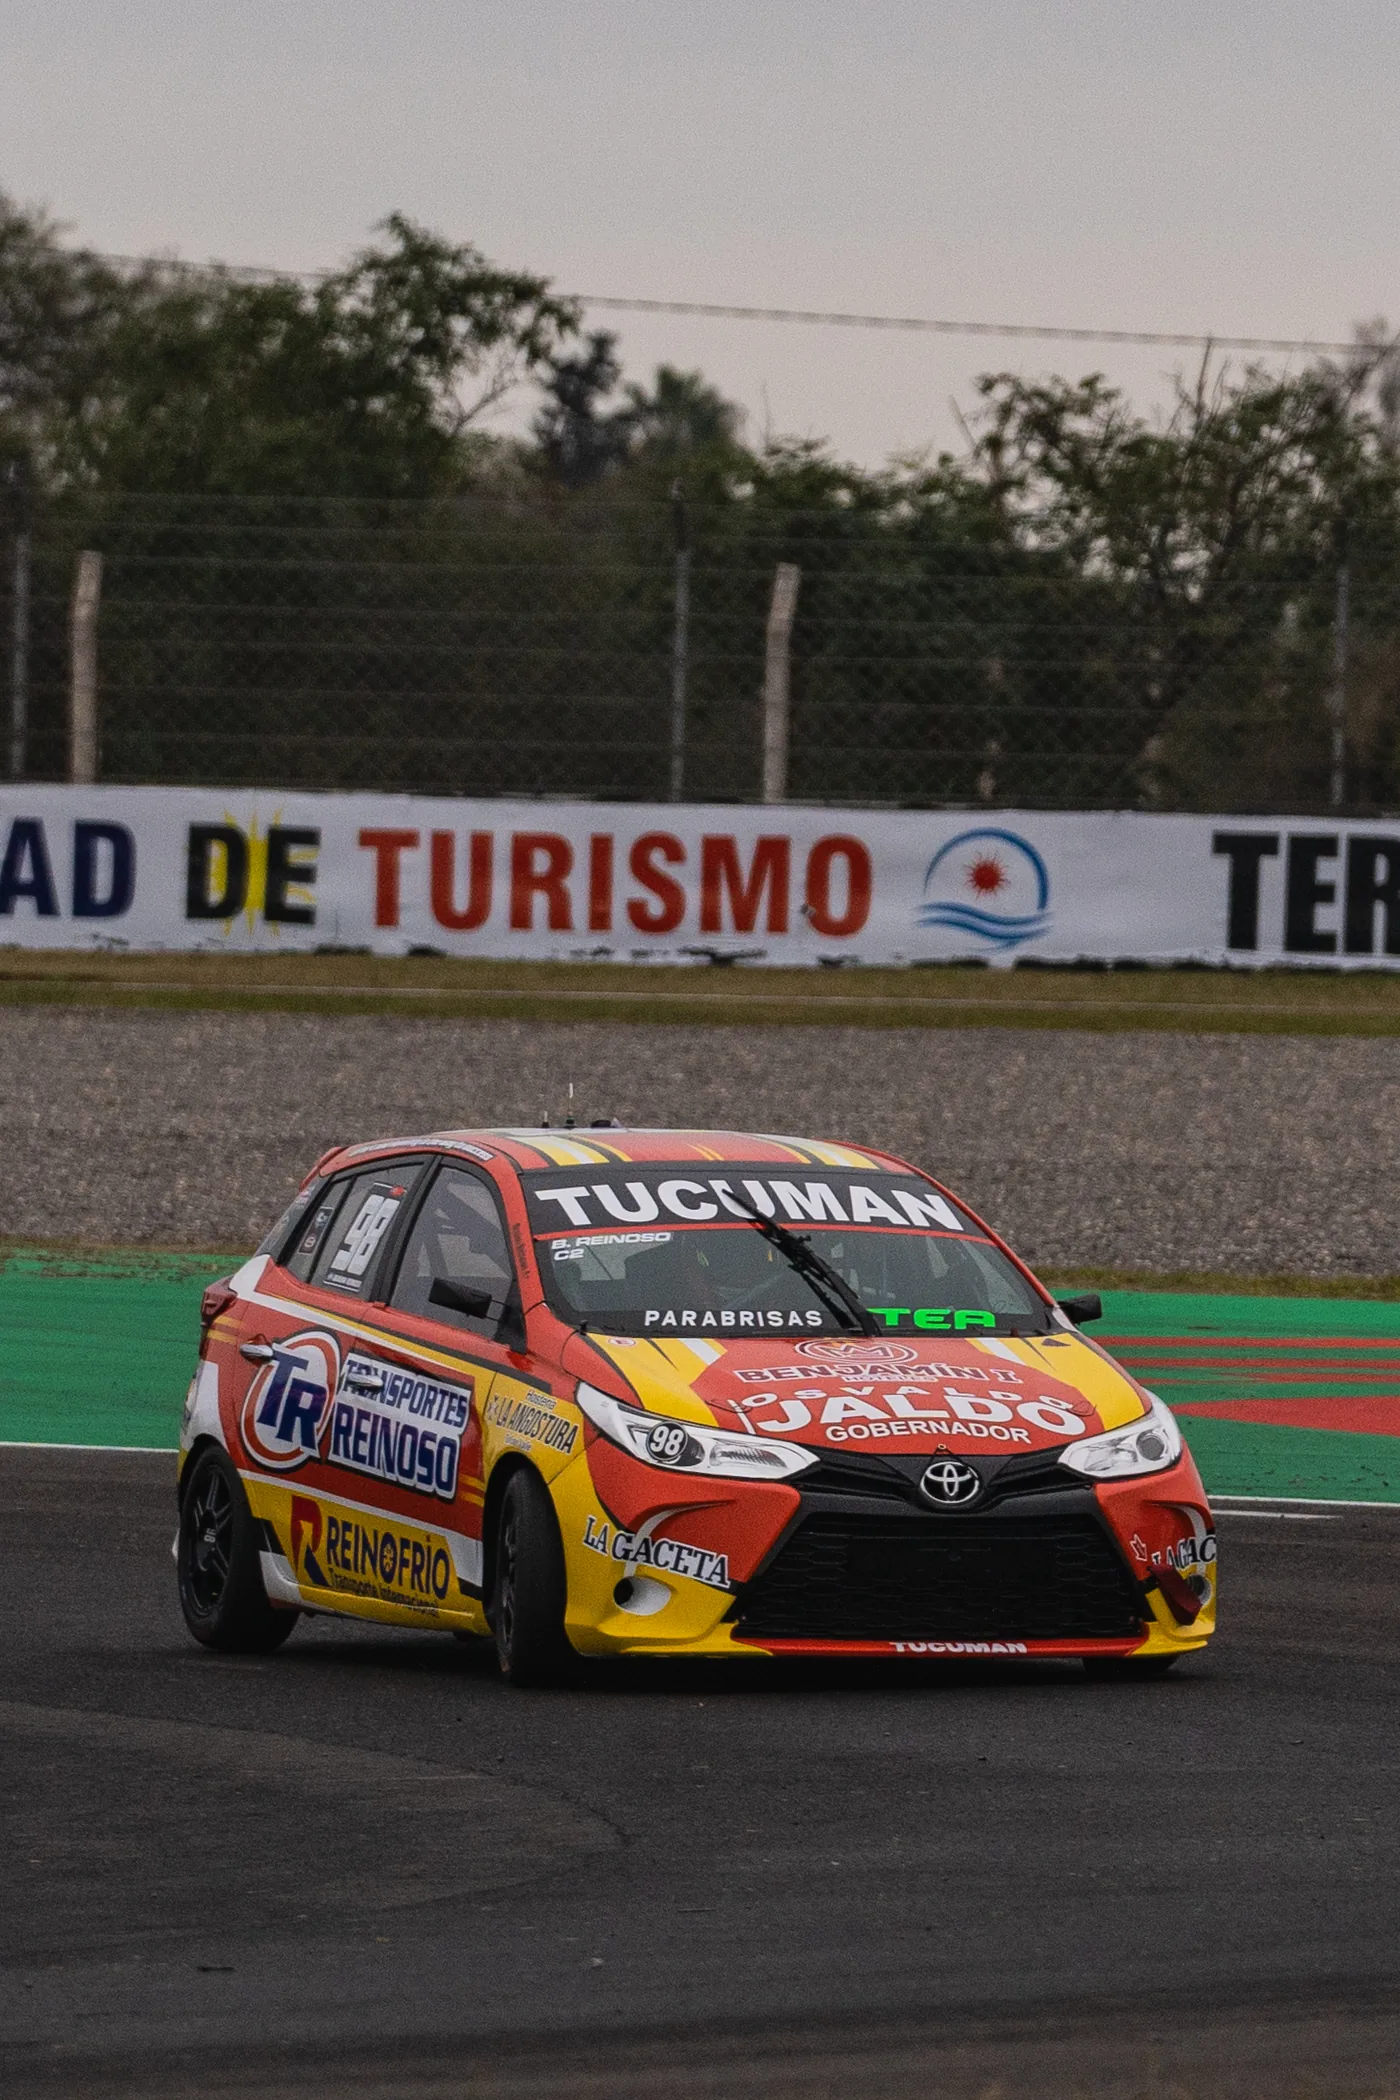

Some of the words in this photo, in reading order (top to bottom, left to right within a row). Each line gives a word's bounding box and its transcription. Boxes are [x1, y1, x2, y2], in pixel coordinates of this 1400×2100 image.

[0, 815, 137, 919] AD
[185, 820, 322, 926] DE
[357, 827, 873, 939] TURISMO
[1211, 829, 1400, 956] TER
[534, 1179, 965, 1231] TUCUMAN
[551, 1239, 571, 1250] B.
[575, 1232, 672, 1247] REINOSO
[553, 1249, 584, 1261] C2
[644, 1309, 824, 1327] PARABRISAS
[866, 1307, 996, 1330] TEA
[735, 1363, 990, 1383] BENJAMÍN
[258, 1350, 327, 1450] TR
[741, 1386, 1064, 1409] OSVALDO
[496, 1397, 514, 1427] LA
[507, 1402, 579, 1454] ANGOSTURA
[757, 1394, 1086, 1437] JALDO
[331, 1401, 459, 1493] REINOSO
[649, 1423, 685, 1455] 98
[825, 1420, 1031, 1445] GOBERNADOR
[584, 1516, 609, 1555] LA
[611, 1533, 731, 1587] GACETA
[890, 1641, 1027, 1654] TUCUMAN
